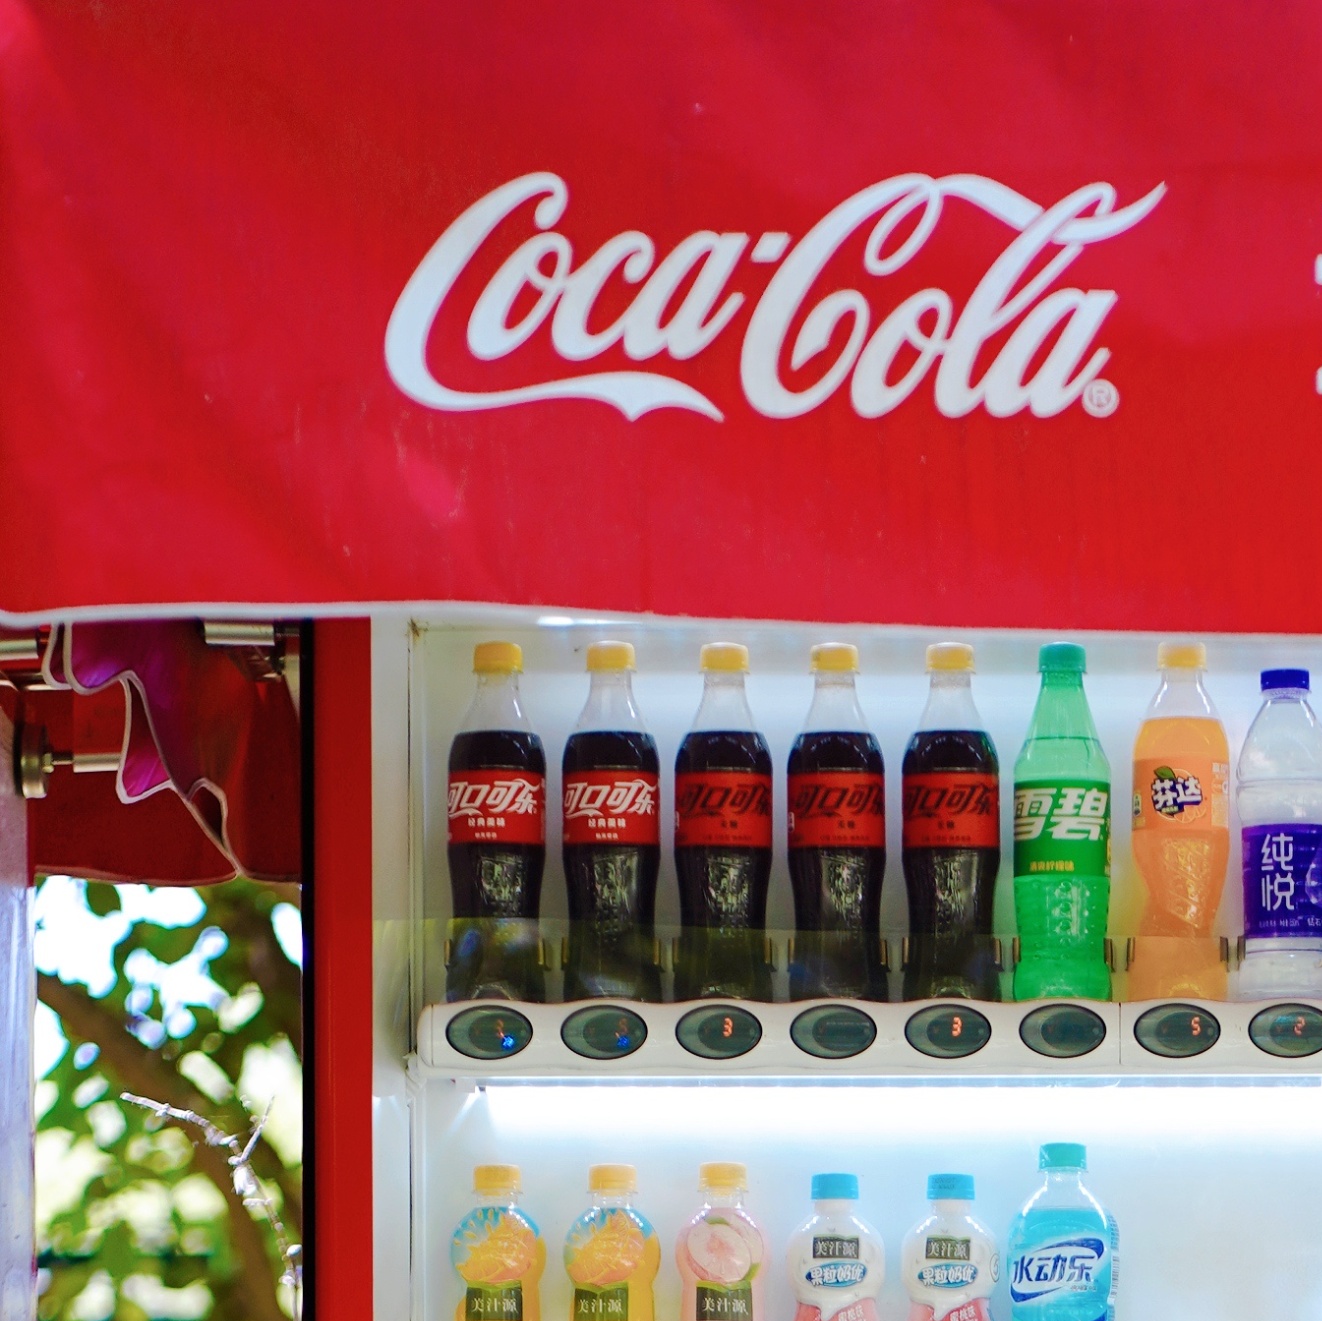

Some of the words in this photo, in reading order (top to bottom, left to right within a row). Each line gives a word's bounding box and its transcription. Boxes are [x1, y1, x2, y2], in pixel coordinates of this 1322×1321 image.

[383, 170, 1167, 422] Coca-Cola
[449, 778, 541, 817] 可口可乐
[565, 778, 658, 817] 可口可乐
[1152, 776, 1203, 809] 芬达
[1014, 787, 1108, 841] 雪碧
[1261, 833, 1295, 911] 纯悦
[810, 1264, 865, 1287] 果粒奶优
[921, 1264, 976, 1287] 果粒奶优
[1013, 1253, 1097, 1284] 水动乐
[472, 1297, 517, 1313] 美汁源
[577, 1298, 623, 1314] 美汁源
[703, 1297, 749, 1314] 美汁源
